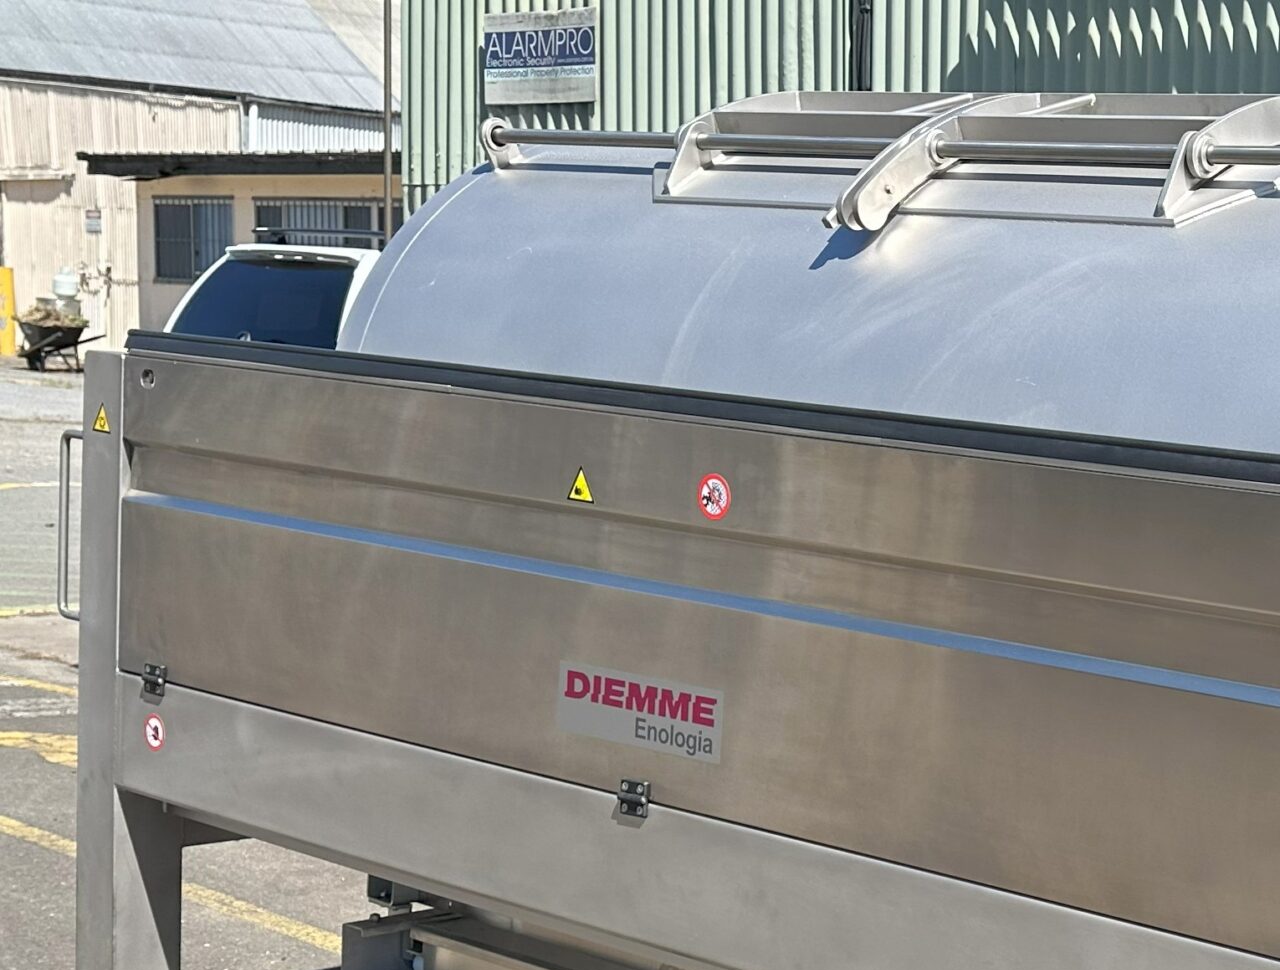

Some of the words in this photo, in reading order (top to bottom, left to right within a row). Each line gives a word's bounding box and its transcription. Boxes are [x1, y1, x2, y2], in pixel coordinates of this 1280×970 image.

[486, 27, 594, 58] ALARMPRO
[486, 57, 525, 67] Electronic
[526, 56, 556, 67] Security
[486, 69, 529, 78] Professional
[530, 68, 559, 77] Property
[560, 66, 594, 76] Protection
[564, 669, 718, 728] DIEMME
[635, 717, 713, 756] Enologia
